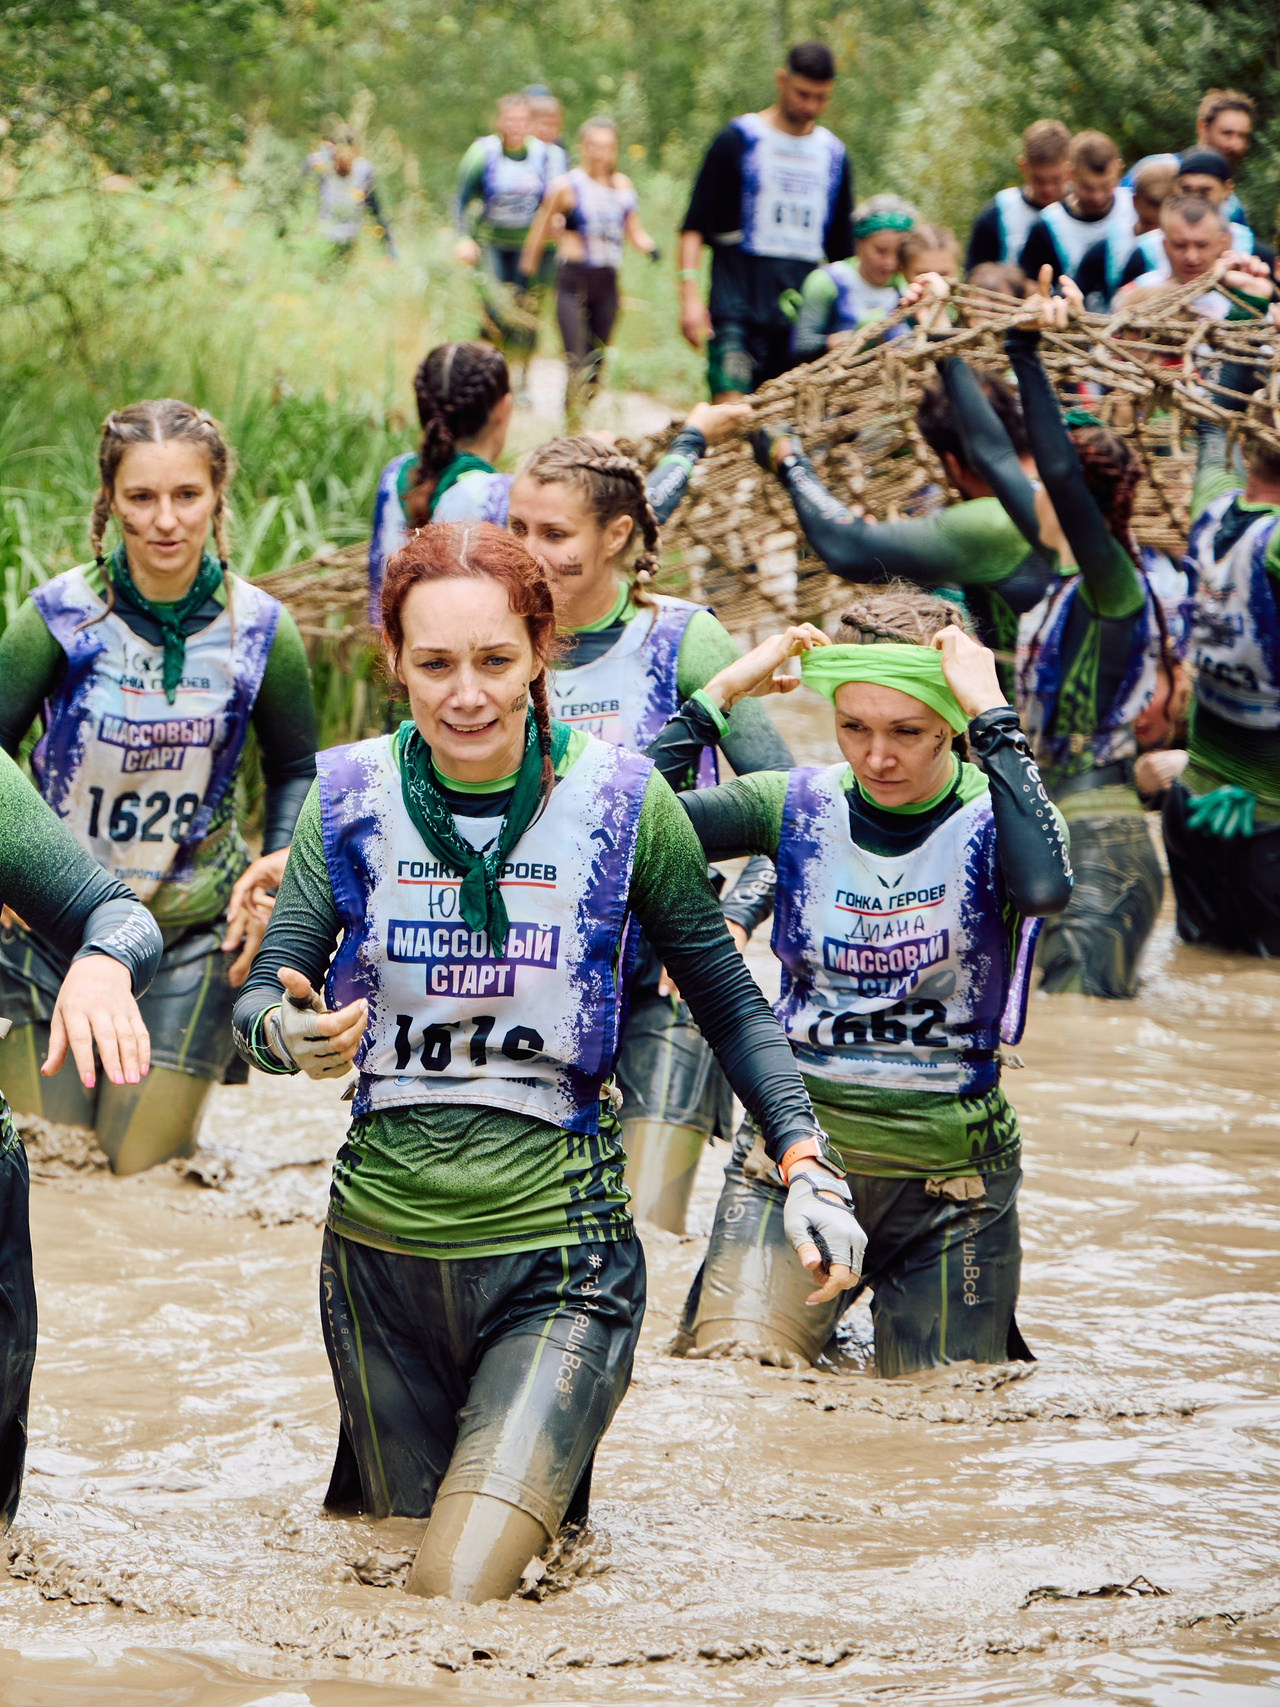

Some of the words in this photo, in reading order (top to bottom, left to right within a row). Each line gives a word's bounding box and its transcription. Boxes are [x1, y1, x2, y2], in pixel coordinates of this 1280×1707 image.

[151, 677, 211, 689] ГОЕВ
[560, 700, 620, 717] ГЕРОЕВ
[101, 715, 212, 747] МАССОВЫЙ
[124, 748, 186, 770] СТАРТ
[88, 786, 200, 844] 1628
[1022, 784, 1058, 857] GLOBAL
[497, 862, 558, 881] РОЕВ
[428, 884, 457, 919] Ю
[835, 889, 883, 911] ГОНКА
[888, 883, 946, 910] ГЕРОЕВ
[393, 923, 553, 962] МАССОЫЙ
[845, 914, 926, 943] ДИАНА
[431, 965, 512, 995] СТАРТ
